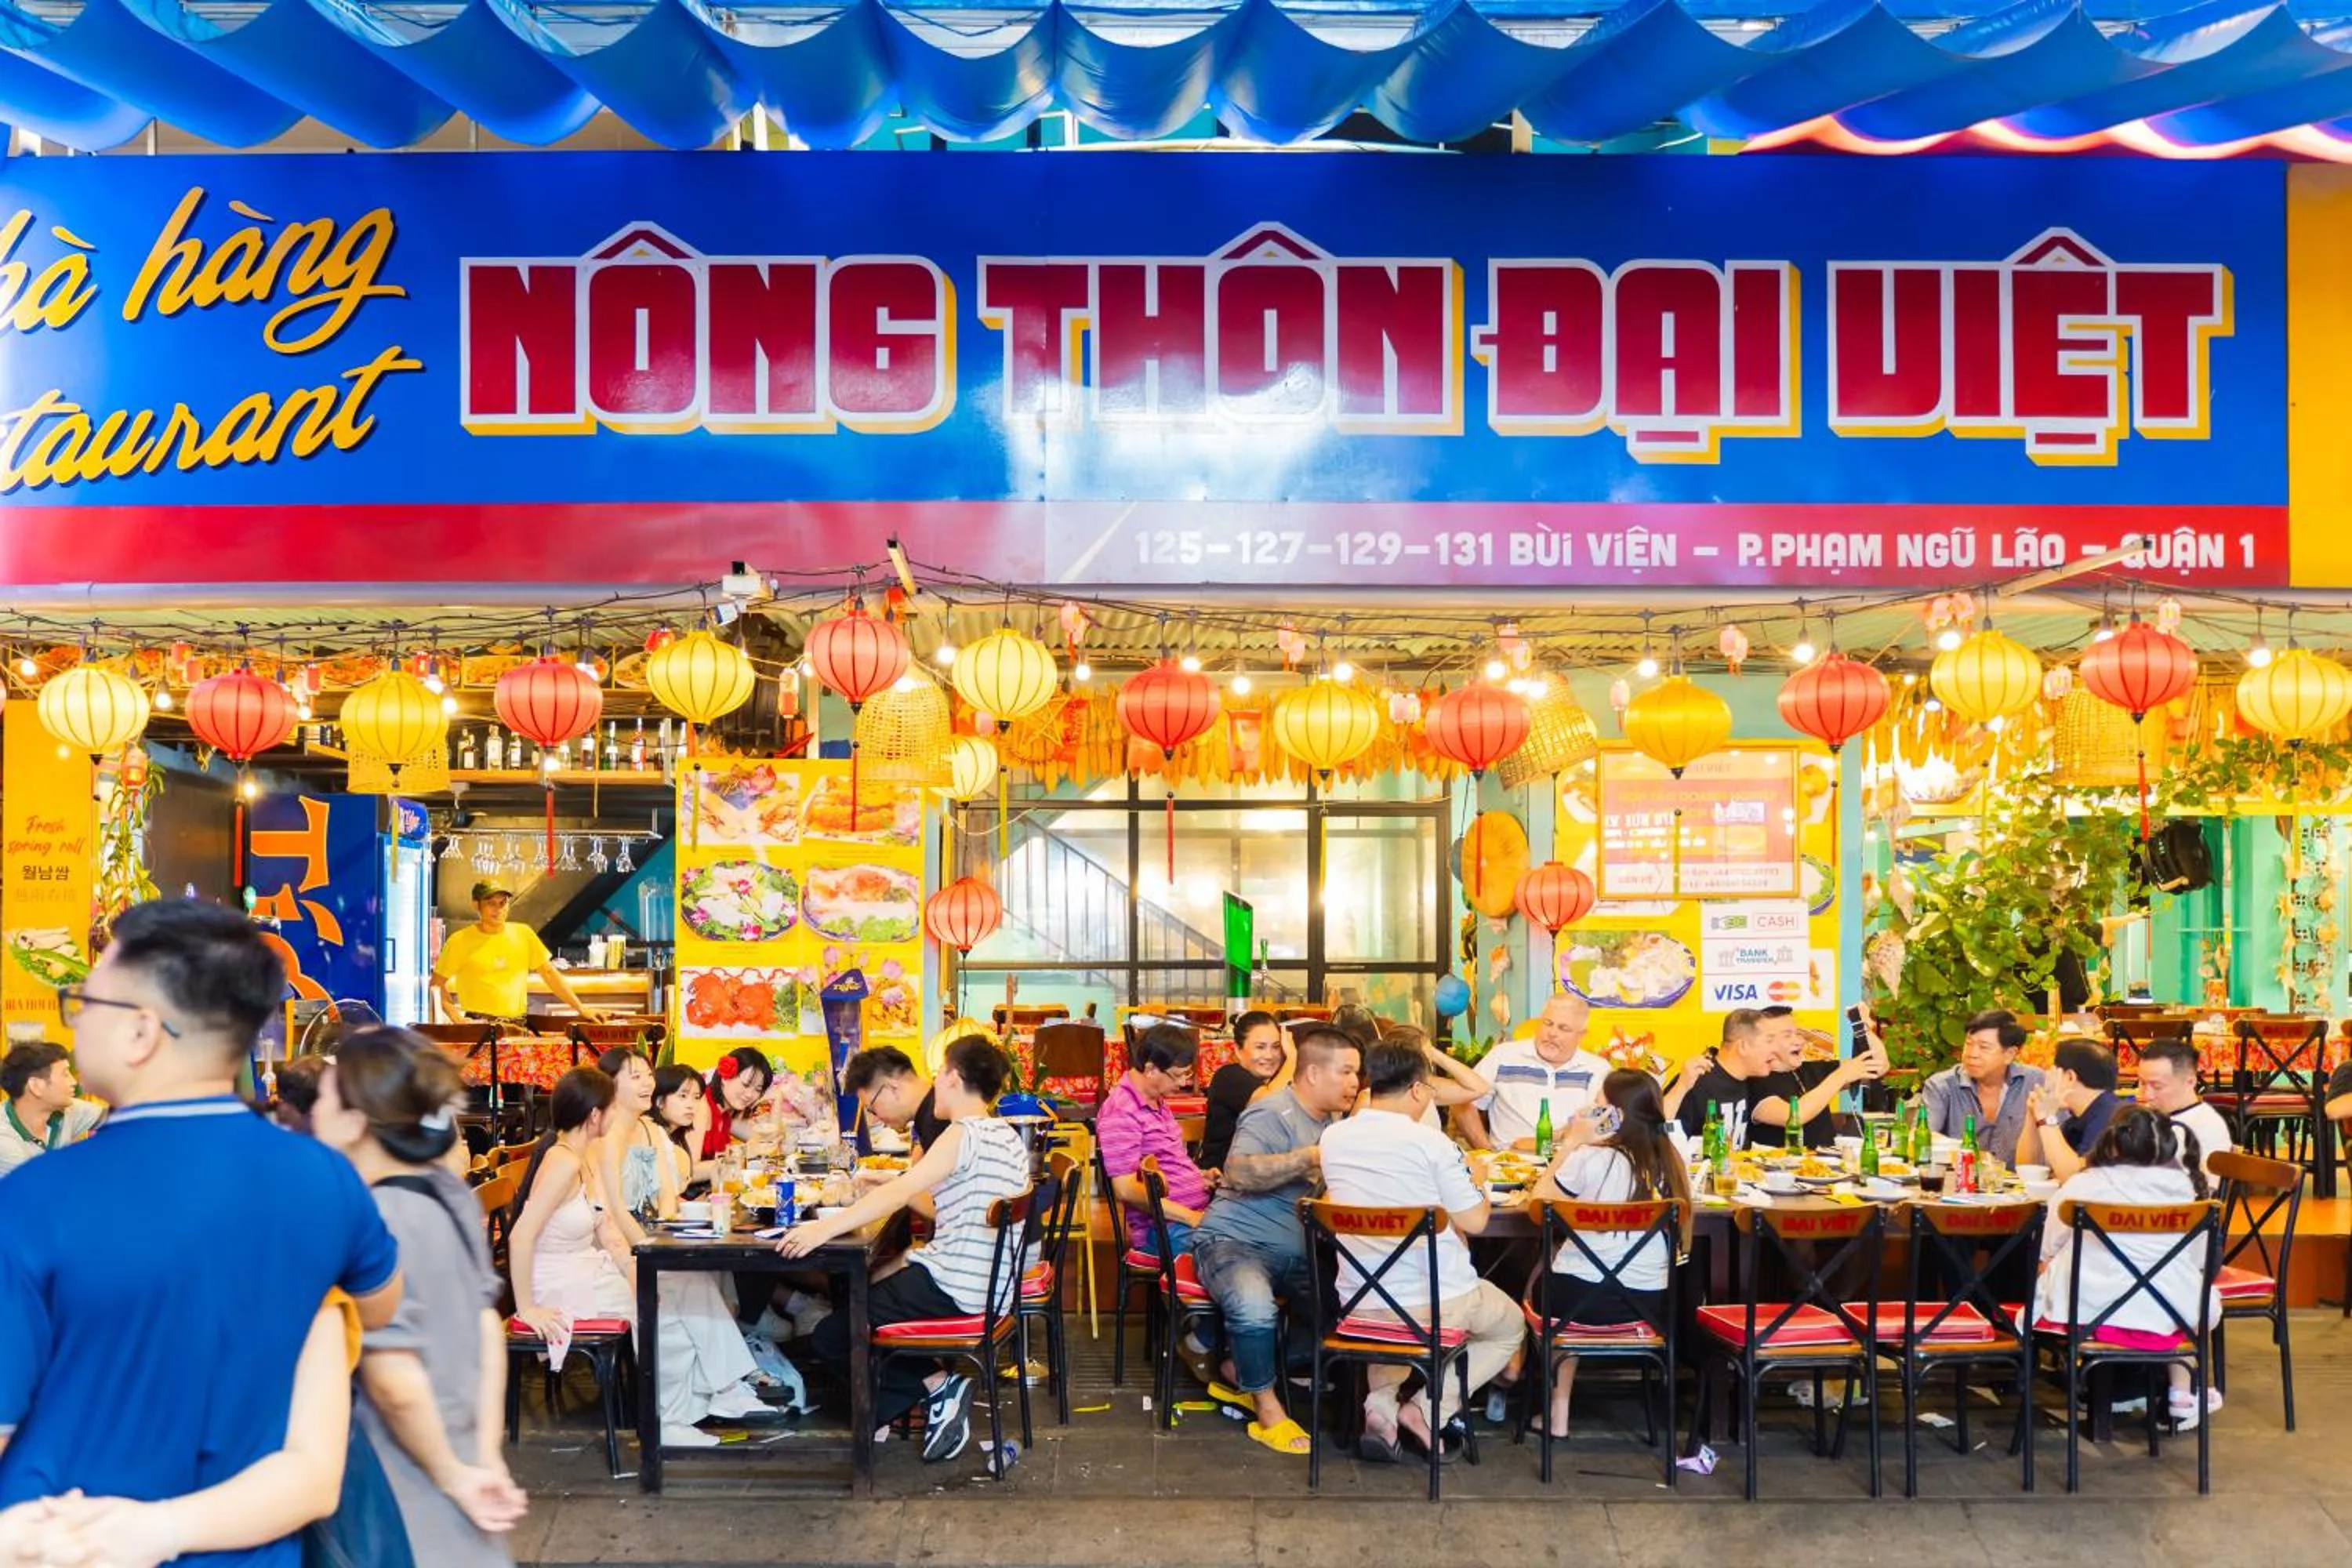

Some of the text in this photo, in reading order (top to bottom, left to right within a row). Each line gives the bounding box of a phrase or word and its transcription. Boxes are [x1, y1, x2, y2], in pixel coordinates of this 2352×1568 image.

[122, 187, 406, 354] hàng
[460, 220, 957, 436] NÔNG
[977, 220, 1465, 437] THÔN
[1471, 258, 1802, 465] ĐẠI
[1897, 527, 1976, 568] NGŨ
[1991, 527, 2066, 568] LÃO
[2120, 526, 2225, 575] QUẬN
[2239, 533, 2255, 568] 1
[1757, 916, 1795, 927] CASH
[1740, 948, 1768, 957] BANK
[1714, 984, 1758, 1001] VISA
